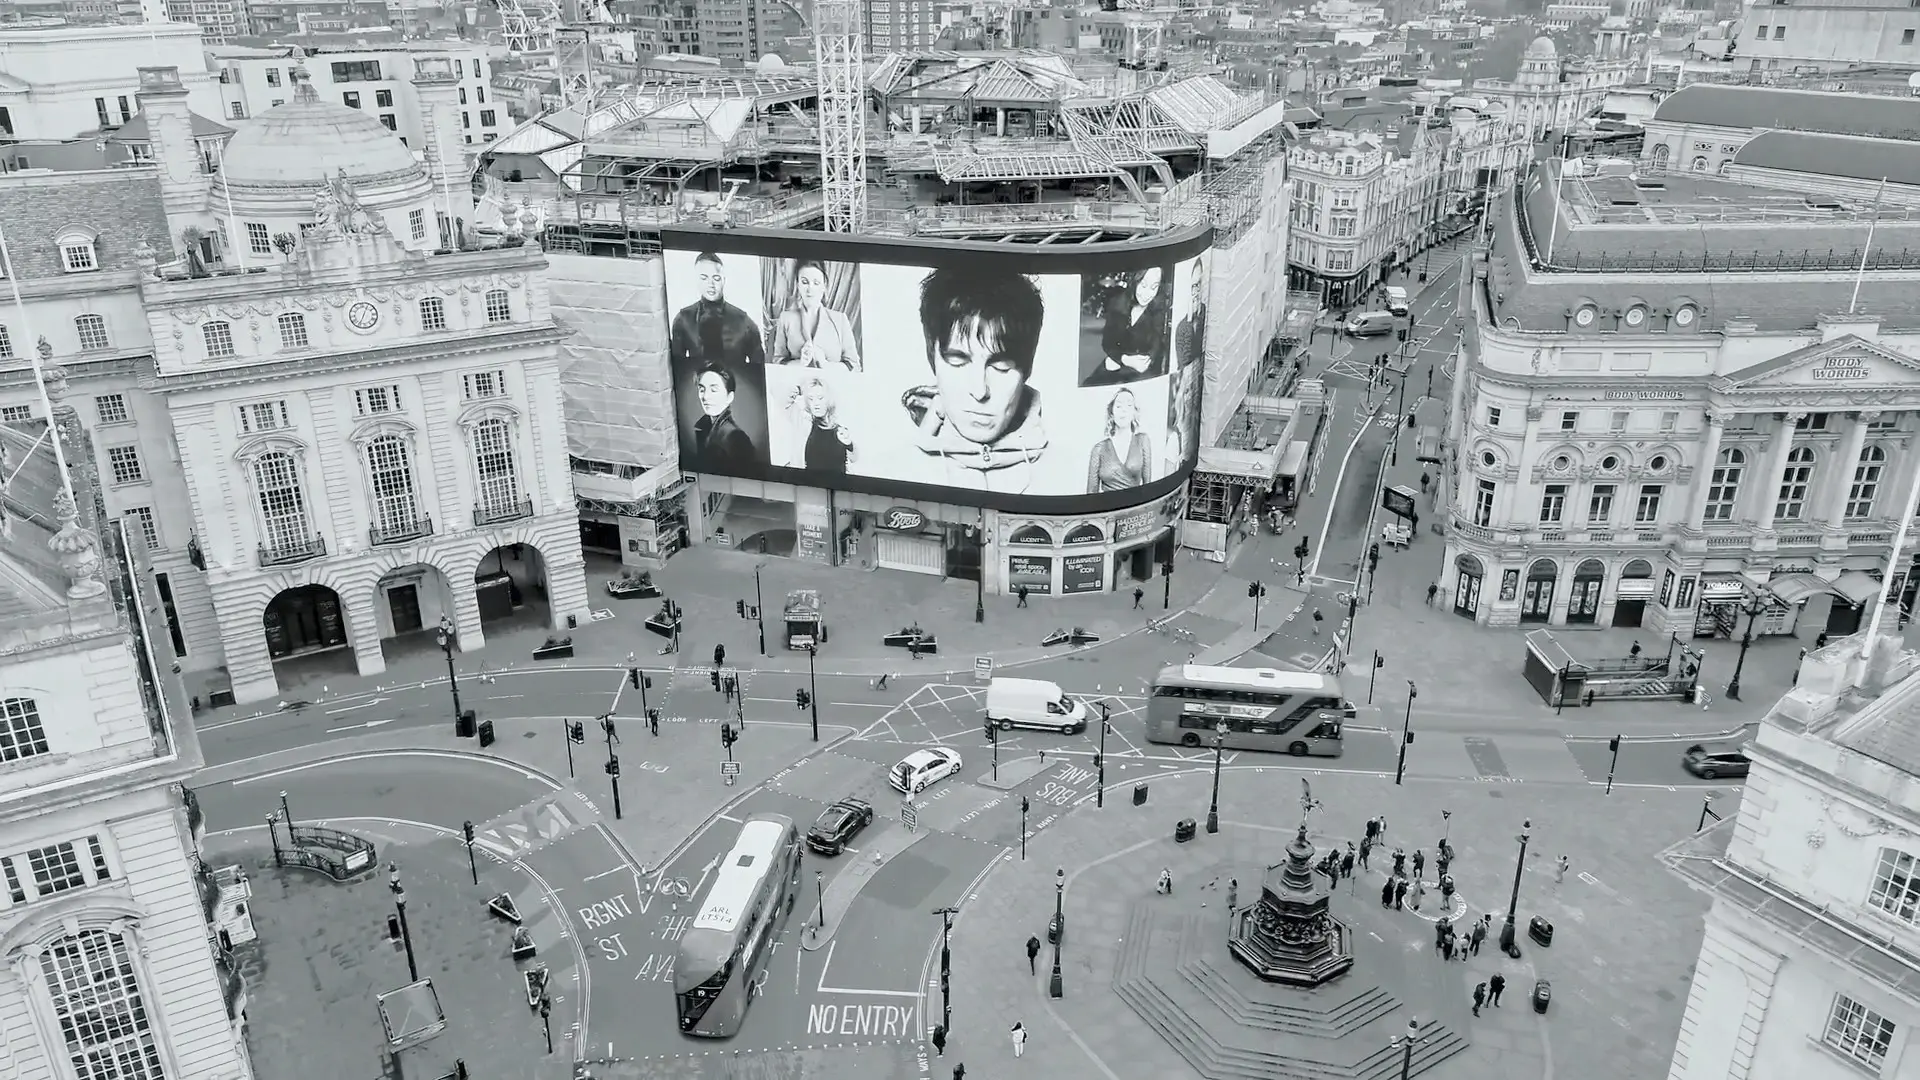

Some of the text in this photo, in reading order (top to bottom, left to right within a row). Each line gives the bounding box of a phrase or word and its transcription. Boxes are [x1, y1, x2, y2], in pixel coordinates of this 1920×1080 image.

[1824, 356, 1867, 369] BODY
[1812, 368, 1870, 380] WORLDS
[1605, 390, 1685, 401] BODY WORLDS
[887, 511, 921, 529] Boots
[1706, 581, 1743, 590] TOBACCO
[1036, 781, 1077, 805] BUS
[578, 893, 633, 930] RGNT
[710, 906, 729, 914] ARL
[598, 933, 628, 960] ST
[698, 989, 706, 997] 19
[807, 999, 914, 1036] NO ENTRY
